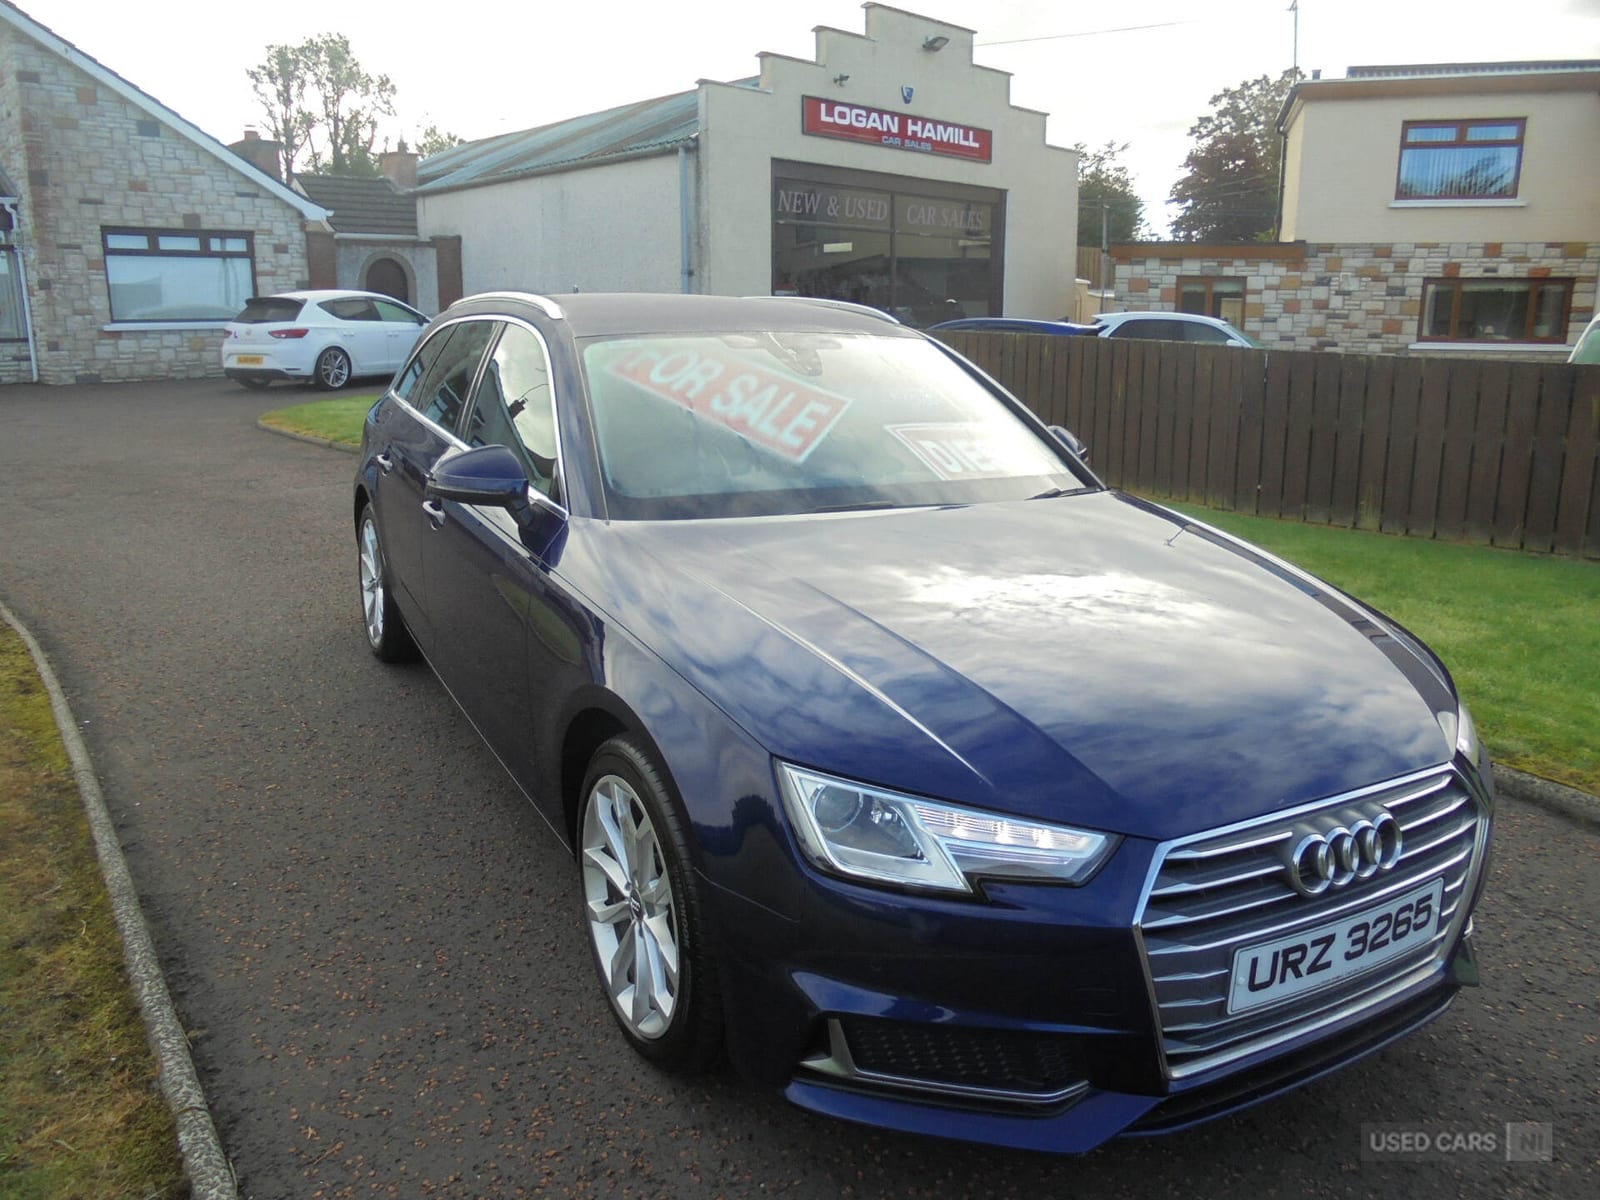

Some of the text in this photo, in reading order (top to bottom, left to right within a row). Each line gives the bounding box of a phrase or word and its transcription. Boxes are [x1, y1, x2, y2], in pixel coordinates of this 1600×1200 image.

[820, 103, 980, 148] LOGAN HAMILL
[881, 135, 932, 151] CAR SALES
[777, 189, 984, 229] NEW & USED CAR SALES
[623, 347, 830, 447] FOR SALE
[1248, 893, 1433, 992] URZ 3265
